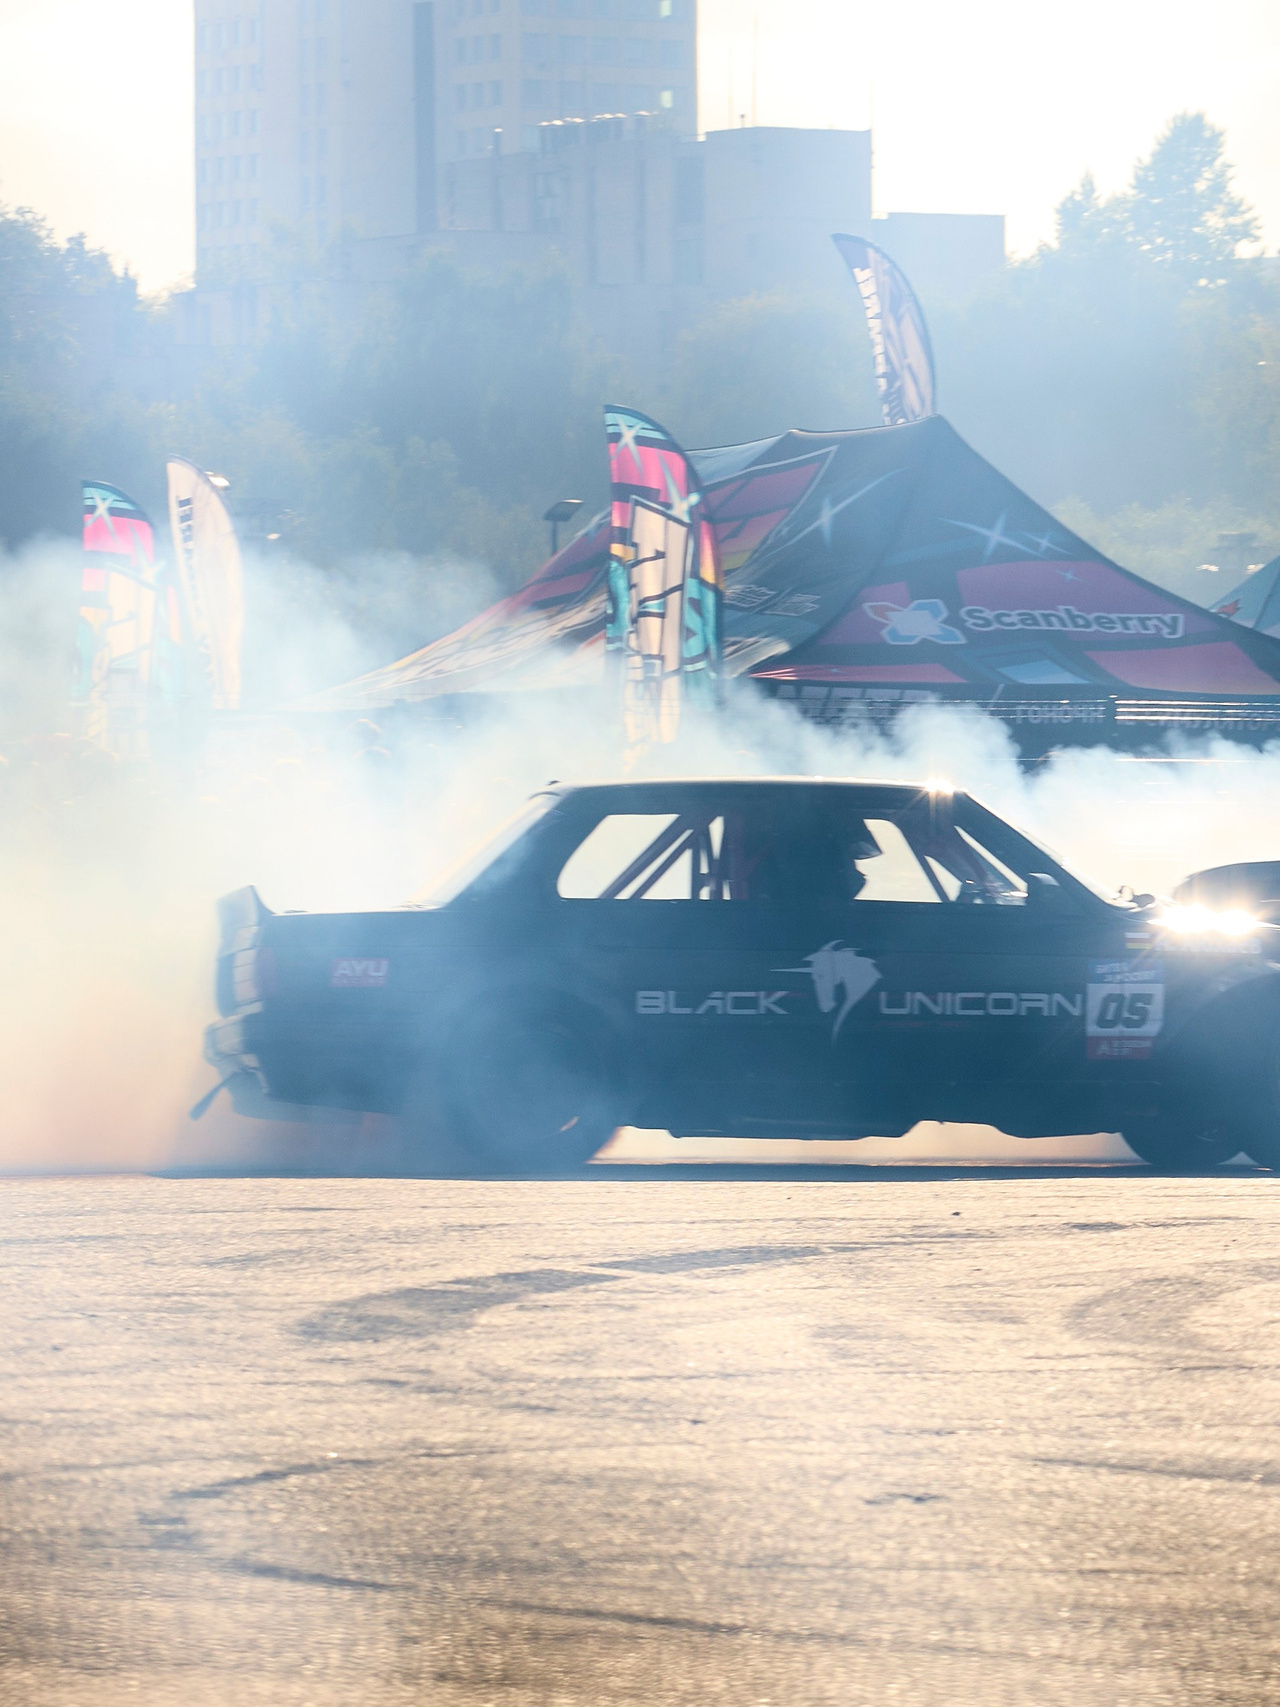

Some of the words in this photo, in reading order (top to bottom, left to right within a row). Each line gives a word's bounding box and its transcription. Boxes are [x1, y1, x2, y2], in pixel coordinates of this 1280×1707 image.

[961, 606, 1183, 638] Scanberry
[333, 960, 389, 977] AYU
[635, 991, 790, 1015] BLACK
[879, 992, 1083, 1016] UNICORN
[1096, 992, 1156, 1029] 05
